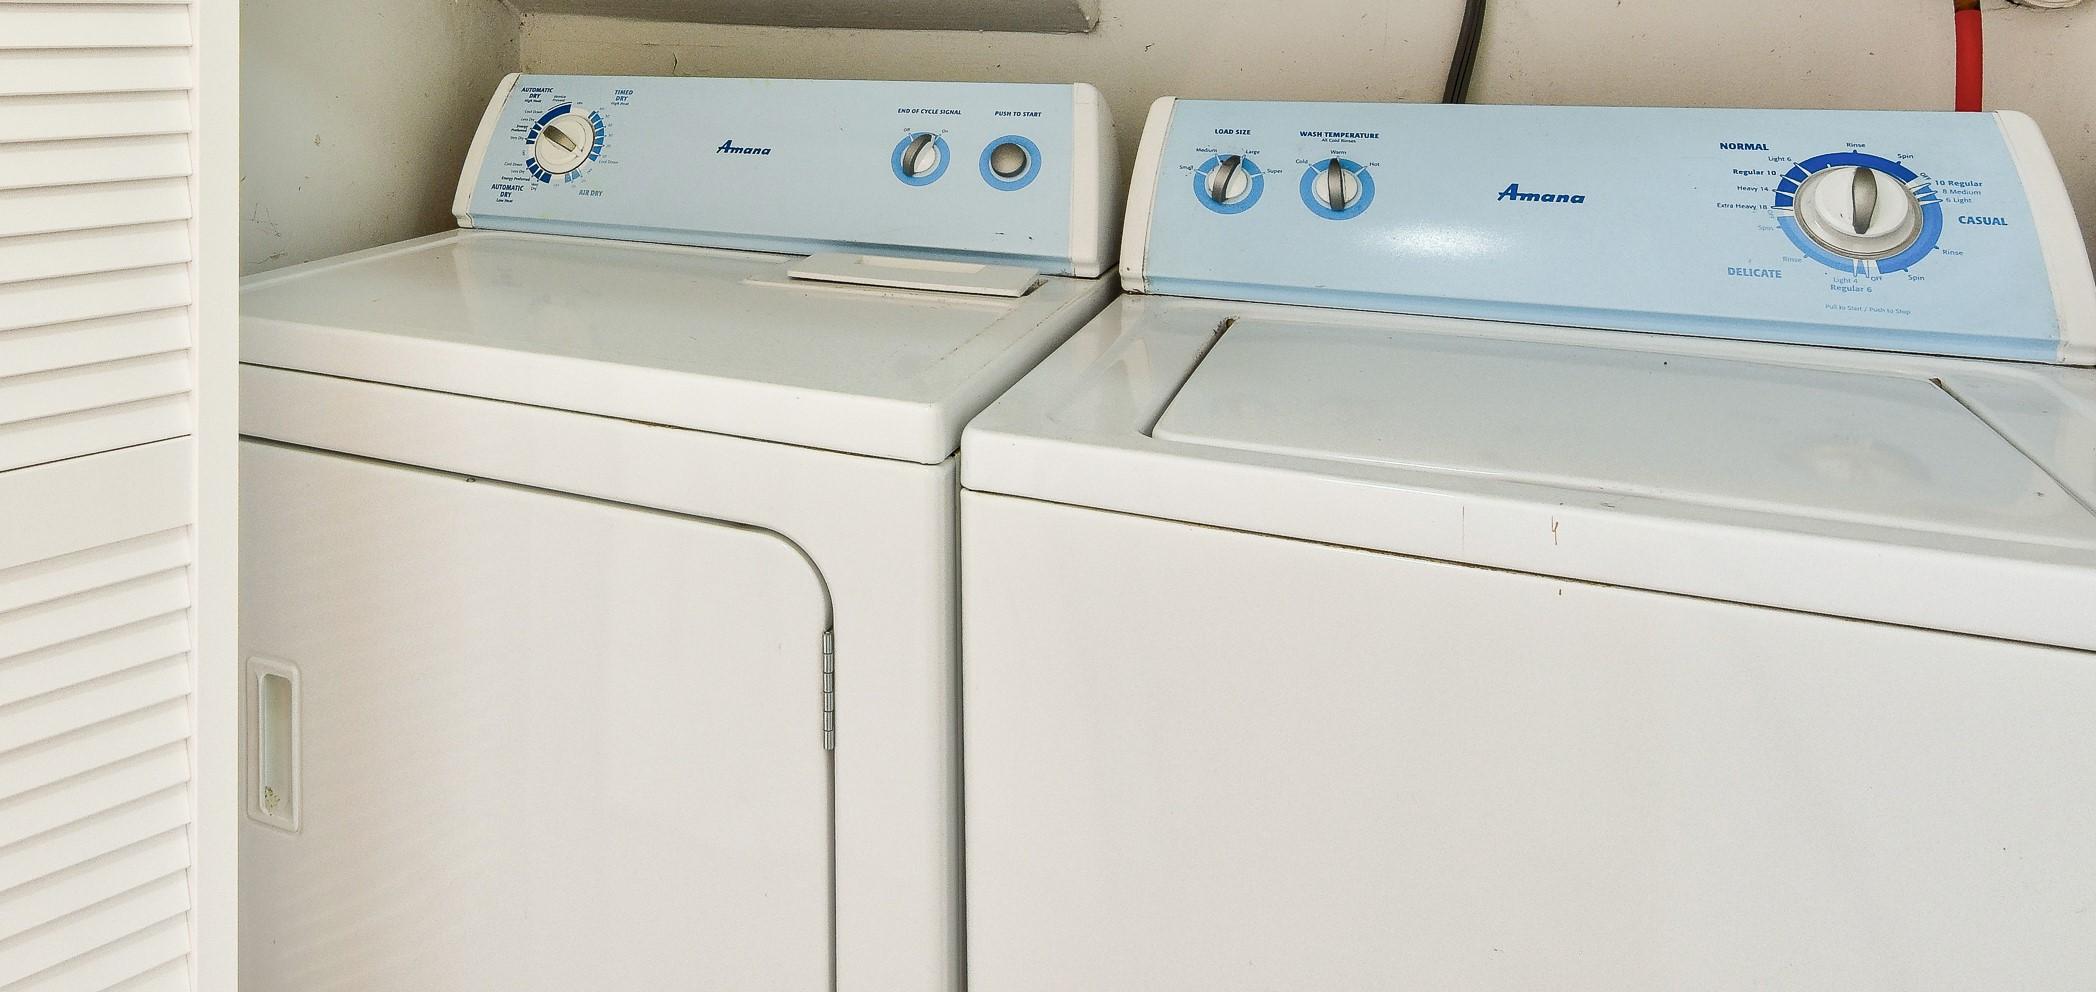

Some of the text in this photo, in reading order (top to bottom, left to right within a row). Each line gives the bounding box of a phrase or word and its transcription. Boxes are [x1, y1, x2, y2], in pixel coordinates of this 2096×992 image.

[716, 140, 771, 155] Amana
[1720, 142, 1769, 150] NORMAL
[490, 184, 524, 192] AUTOMATIC
[1498, 184, 1585, 203] Amana
[1958, 216, 2008, 226] CASUAL
[1728, 267, 1782, 278] DELICATE
[1830, 284, 1864, 292] Regular
